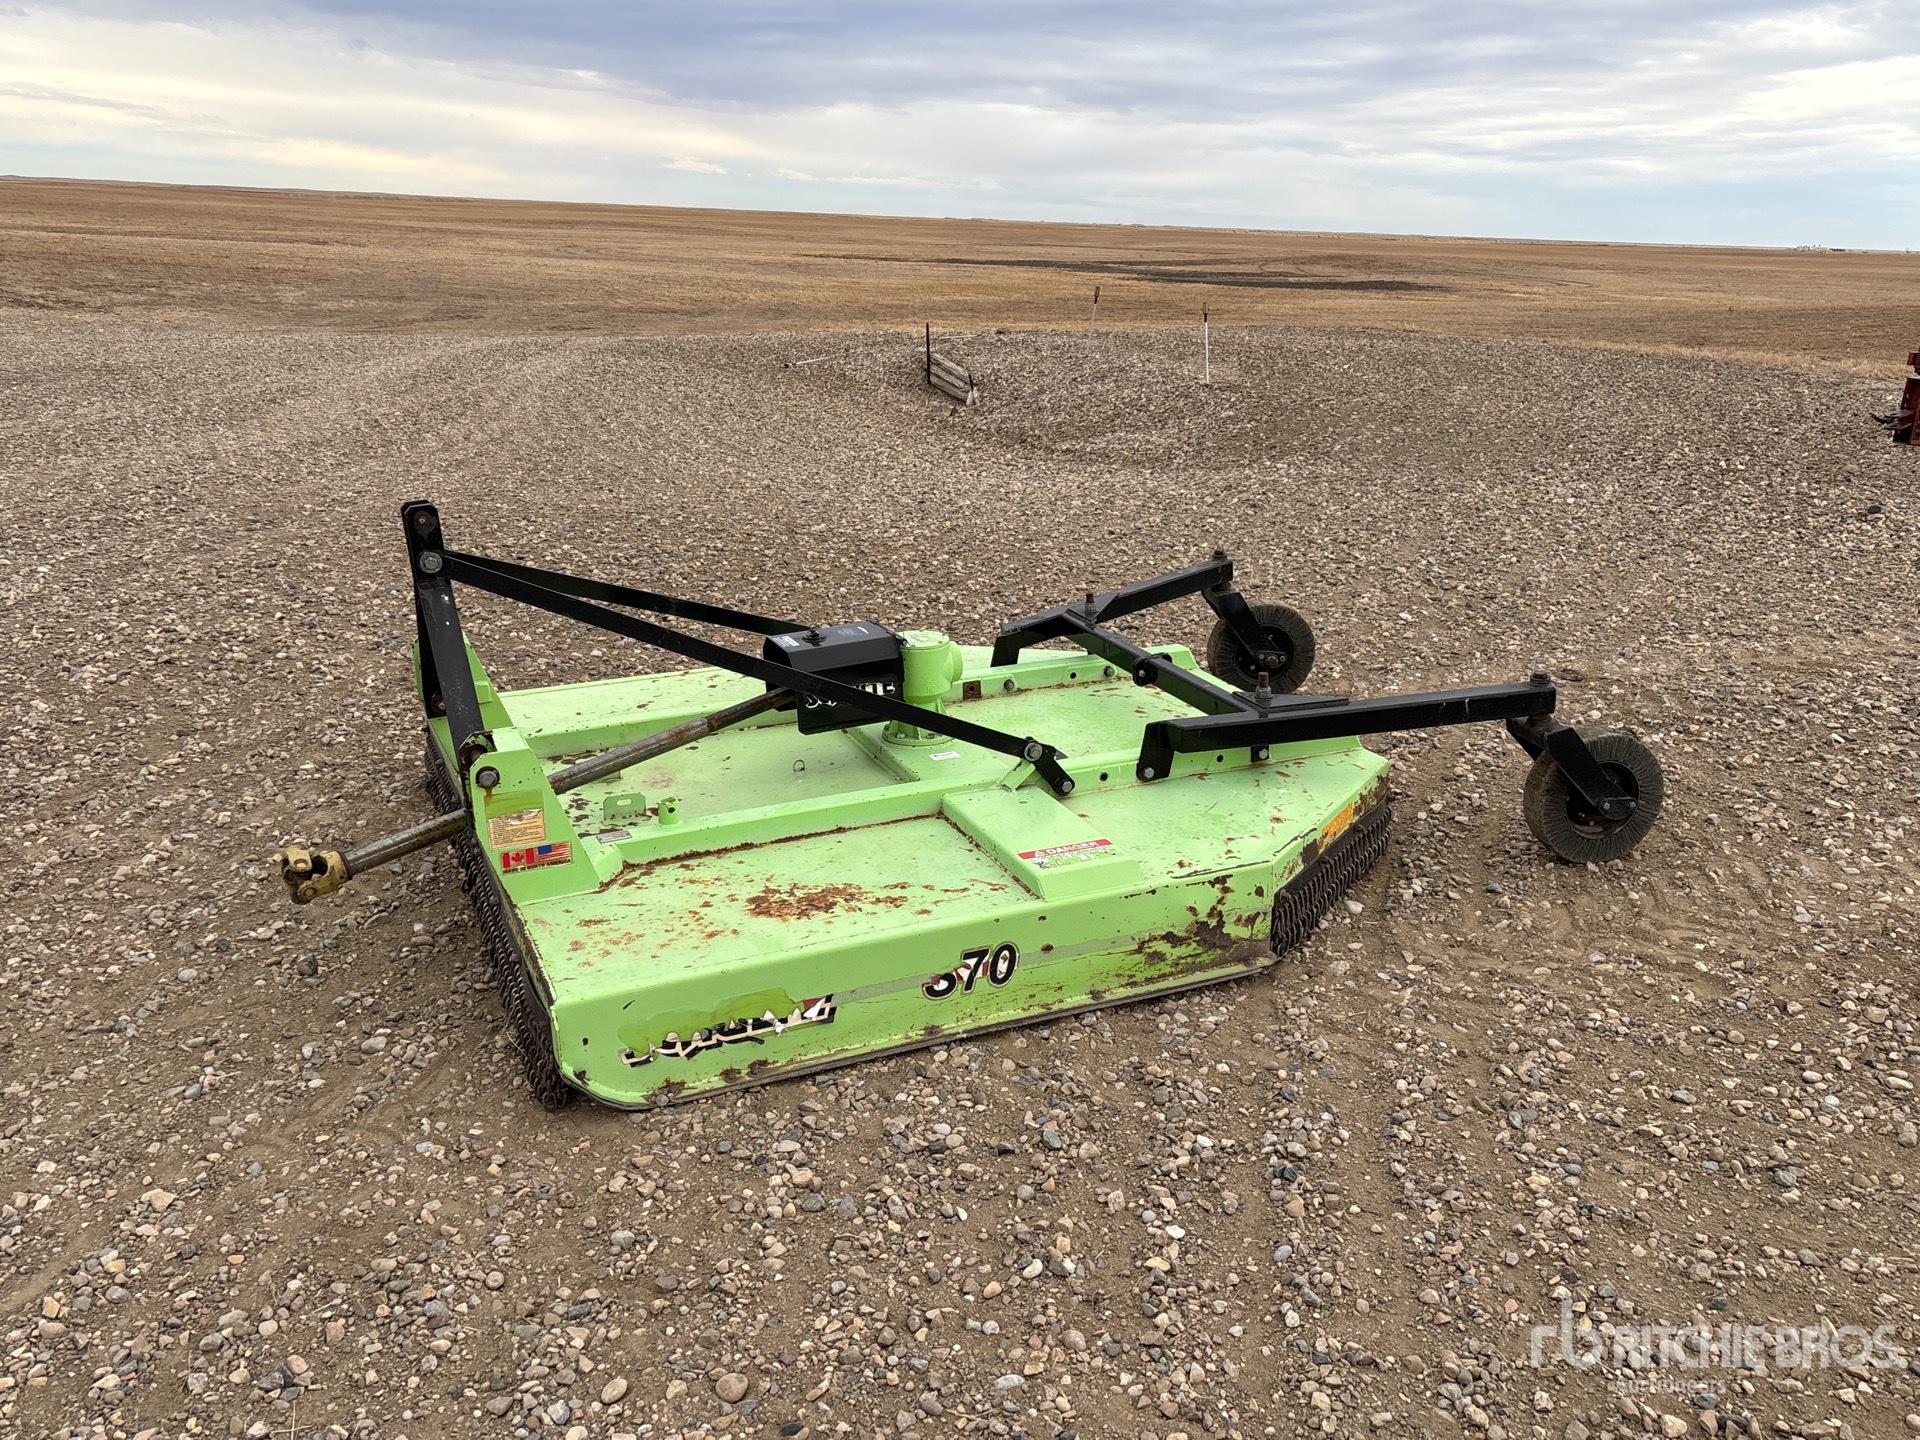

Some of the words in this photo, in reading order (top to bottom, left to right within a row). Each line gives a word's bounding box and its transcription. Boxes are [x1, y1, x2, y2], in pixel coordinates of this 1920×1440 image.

[1045, 841, 1099, 855] DANGER
[503, 866, 519, 874] MADE
[527, 862, 546, 870] NORTH
[546, 858, 571, 866] AMERICA
